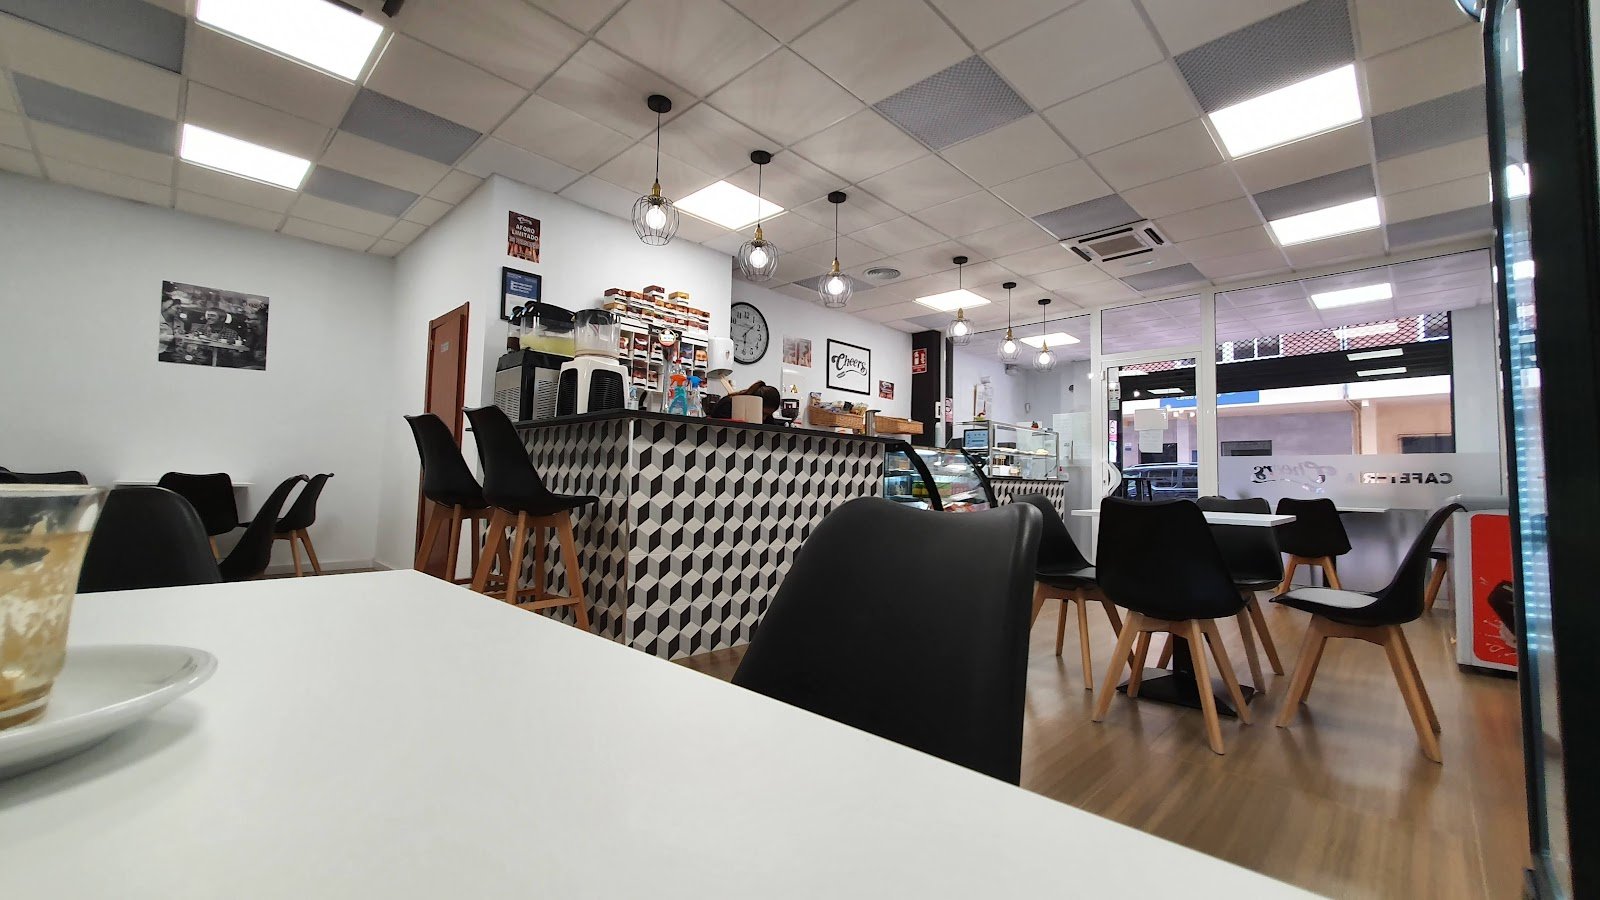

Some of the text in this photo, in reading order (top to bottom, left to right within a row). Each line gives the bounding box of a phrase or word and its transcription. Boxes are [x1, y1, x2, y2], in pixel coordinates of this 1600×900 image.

[511, 229, 539, 241] LIMITADO
[516, 224, 535, 234] AFORO
[831, 353, 867, 374] Cheers
